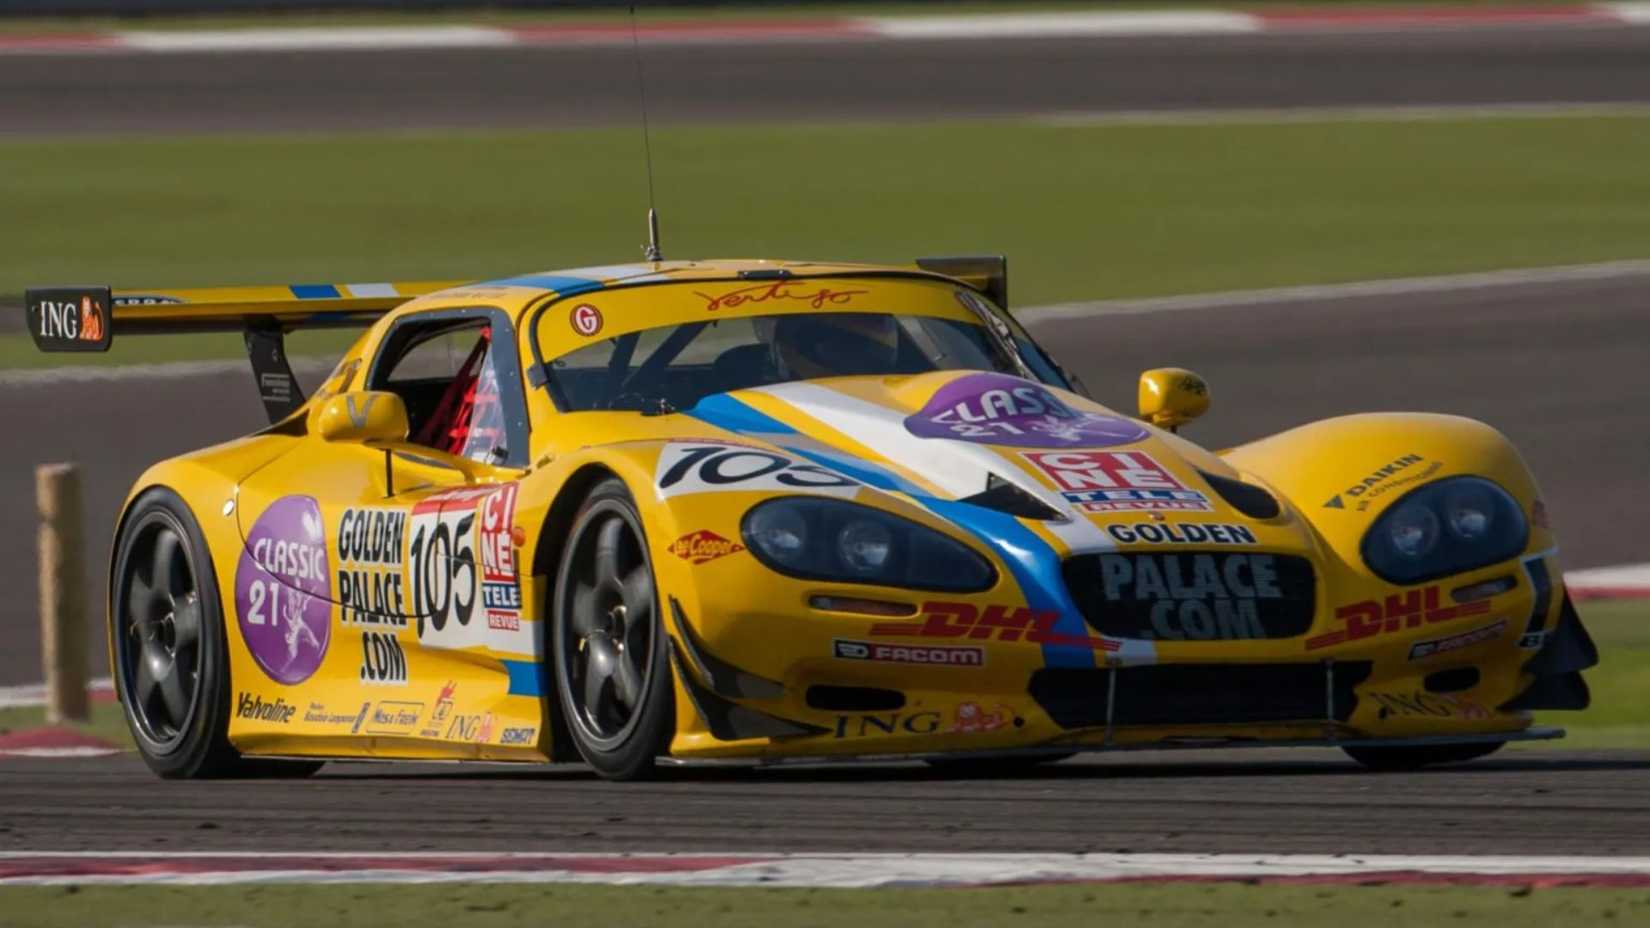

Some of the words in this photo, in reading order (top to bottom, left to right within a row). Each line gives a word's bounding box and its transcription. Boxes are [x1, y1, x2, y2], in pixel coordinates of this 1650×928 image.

[40, 301, 77, 339] ING
[658, 446, 864, 489] 105
[1345, 453, 1424, 496] DAIKIN
[338, 508, 406, 564] GOLDEN
[1108, 523, 1257, 544] GOLDEN
[254, 537, 325, 582] CLASSIC
[410, 511, 476, 639] 105
[1103, 554, 1282, 599] PALACE
[247, 580, 278, 627] 21
[338, 569, 407, 626] PALACE
[483, 585, 520, 607] TELE
[1335, 586, 1456, 641] DHL
[918, 601, 1074, 645] DHL
[361, 631, 407, 681] .COM
[874, 646, 978, 664] FACOM
[236, 691, 297, 724] Valvoline
[445, 714, 481, 741] ING
[835, 711, 942, 739] ING
